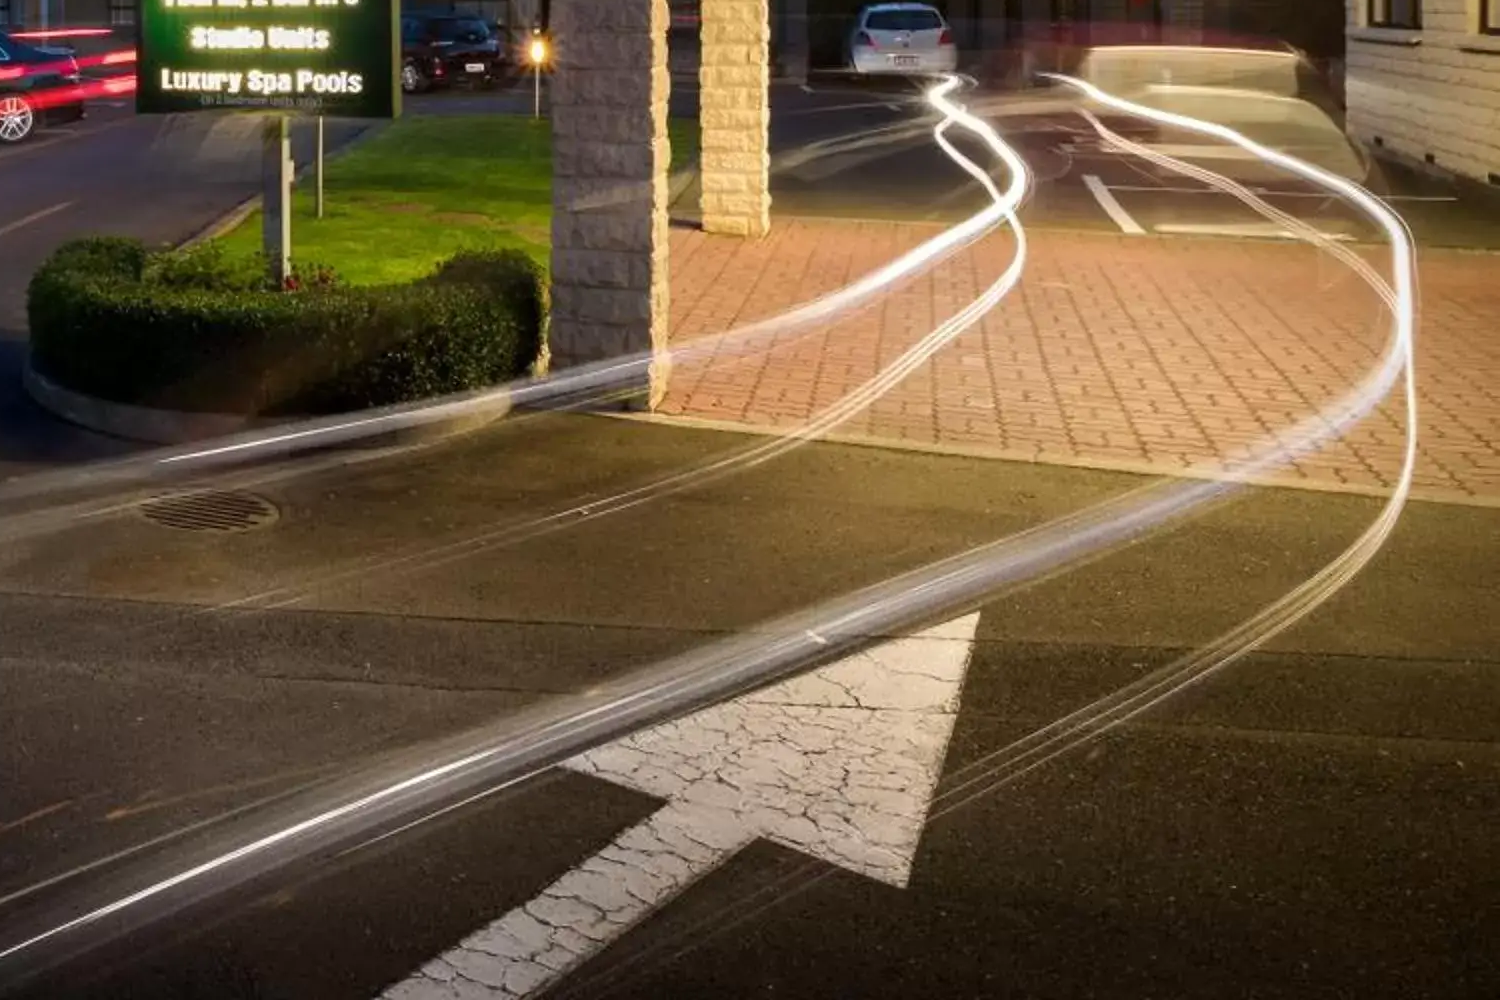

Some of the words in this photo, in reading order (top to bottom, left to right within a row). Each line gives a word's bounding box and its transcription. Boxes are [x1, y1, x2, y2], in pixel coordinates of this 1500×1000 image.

[161, 68, 242, 93] Luxury
[247, 69, 292, 94] Spa
[297, 69, 363, 93] Pools
